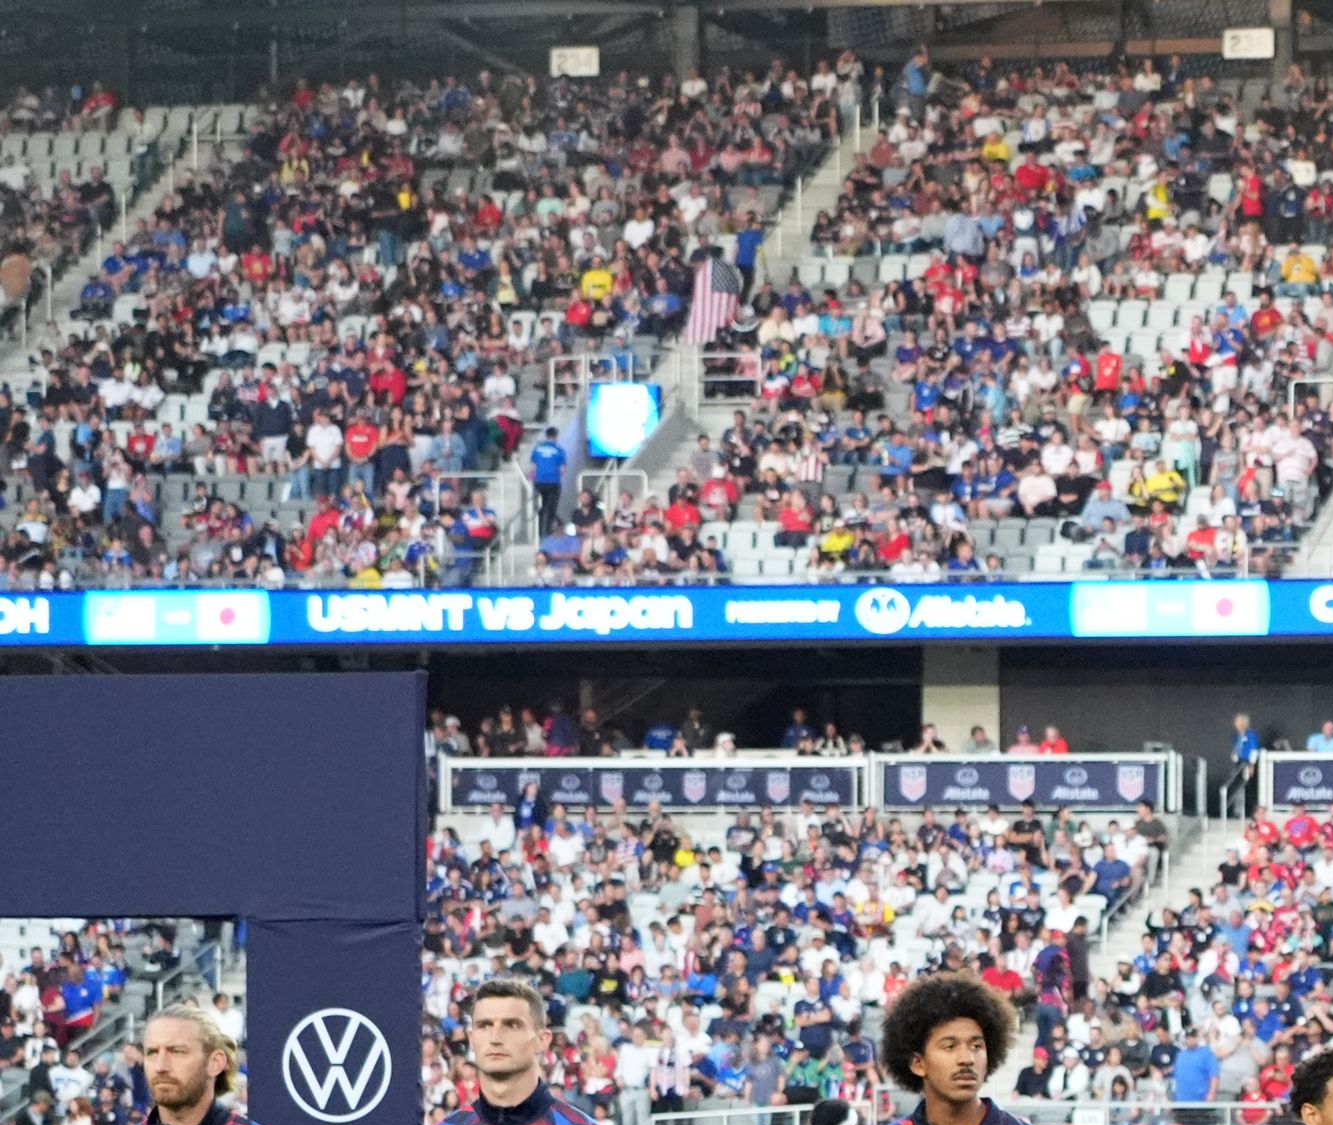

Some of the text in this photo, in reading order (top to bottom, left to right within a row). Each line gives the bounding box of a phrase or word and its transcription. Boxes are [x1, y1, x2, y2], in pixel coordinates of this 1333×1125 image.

[303, 593, 693, 634] USMNT vs Japan
[283, 1008, 391, 1122] VW
